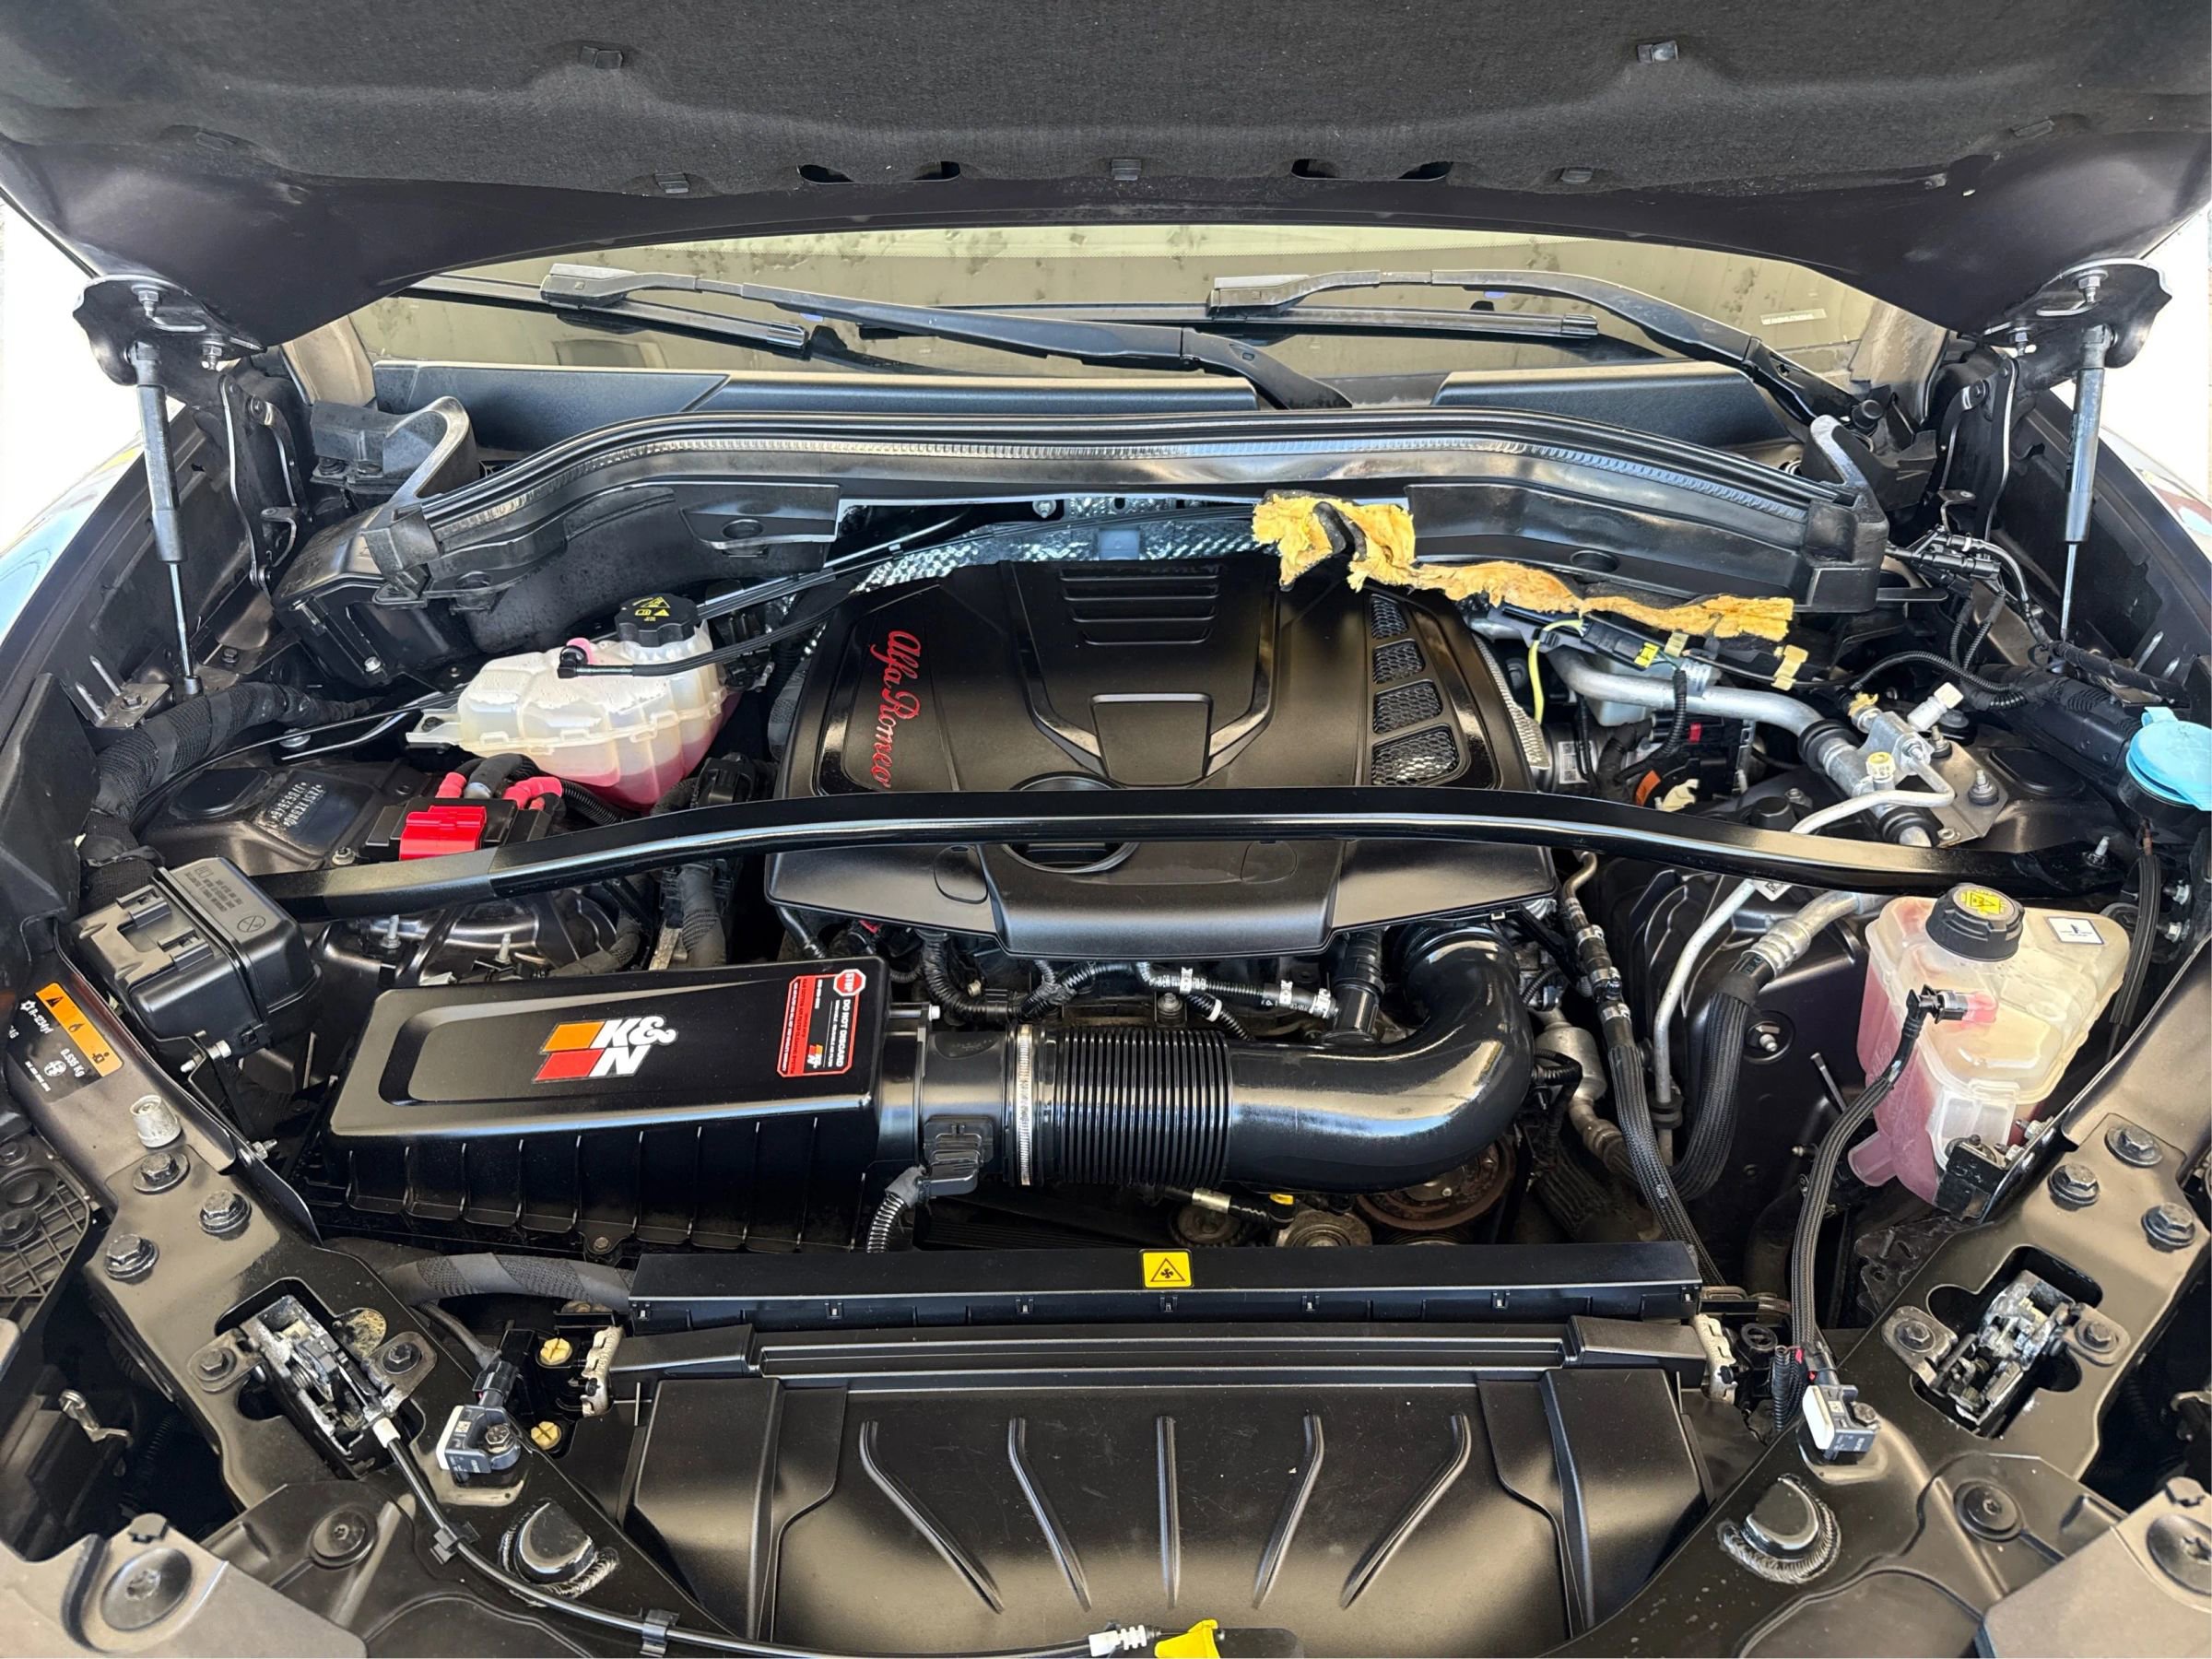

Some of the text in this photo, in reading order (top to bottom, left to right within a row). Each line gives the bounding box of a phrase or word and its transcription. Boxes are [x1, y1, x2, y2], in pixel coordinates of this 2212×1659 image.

[871, 688, 921, 789] Romeo
[842, 999, 851, 1011] DO
[841, 1012, 850, 1030] NOT
[836, 1030, 847, 1067] DISCARD
